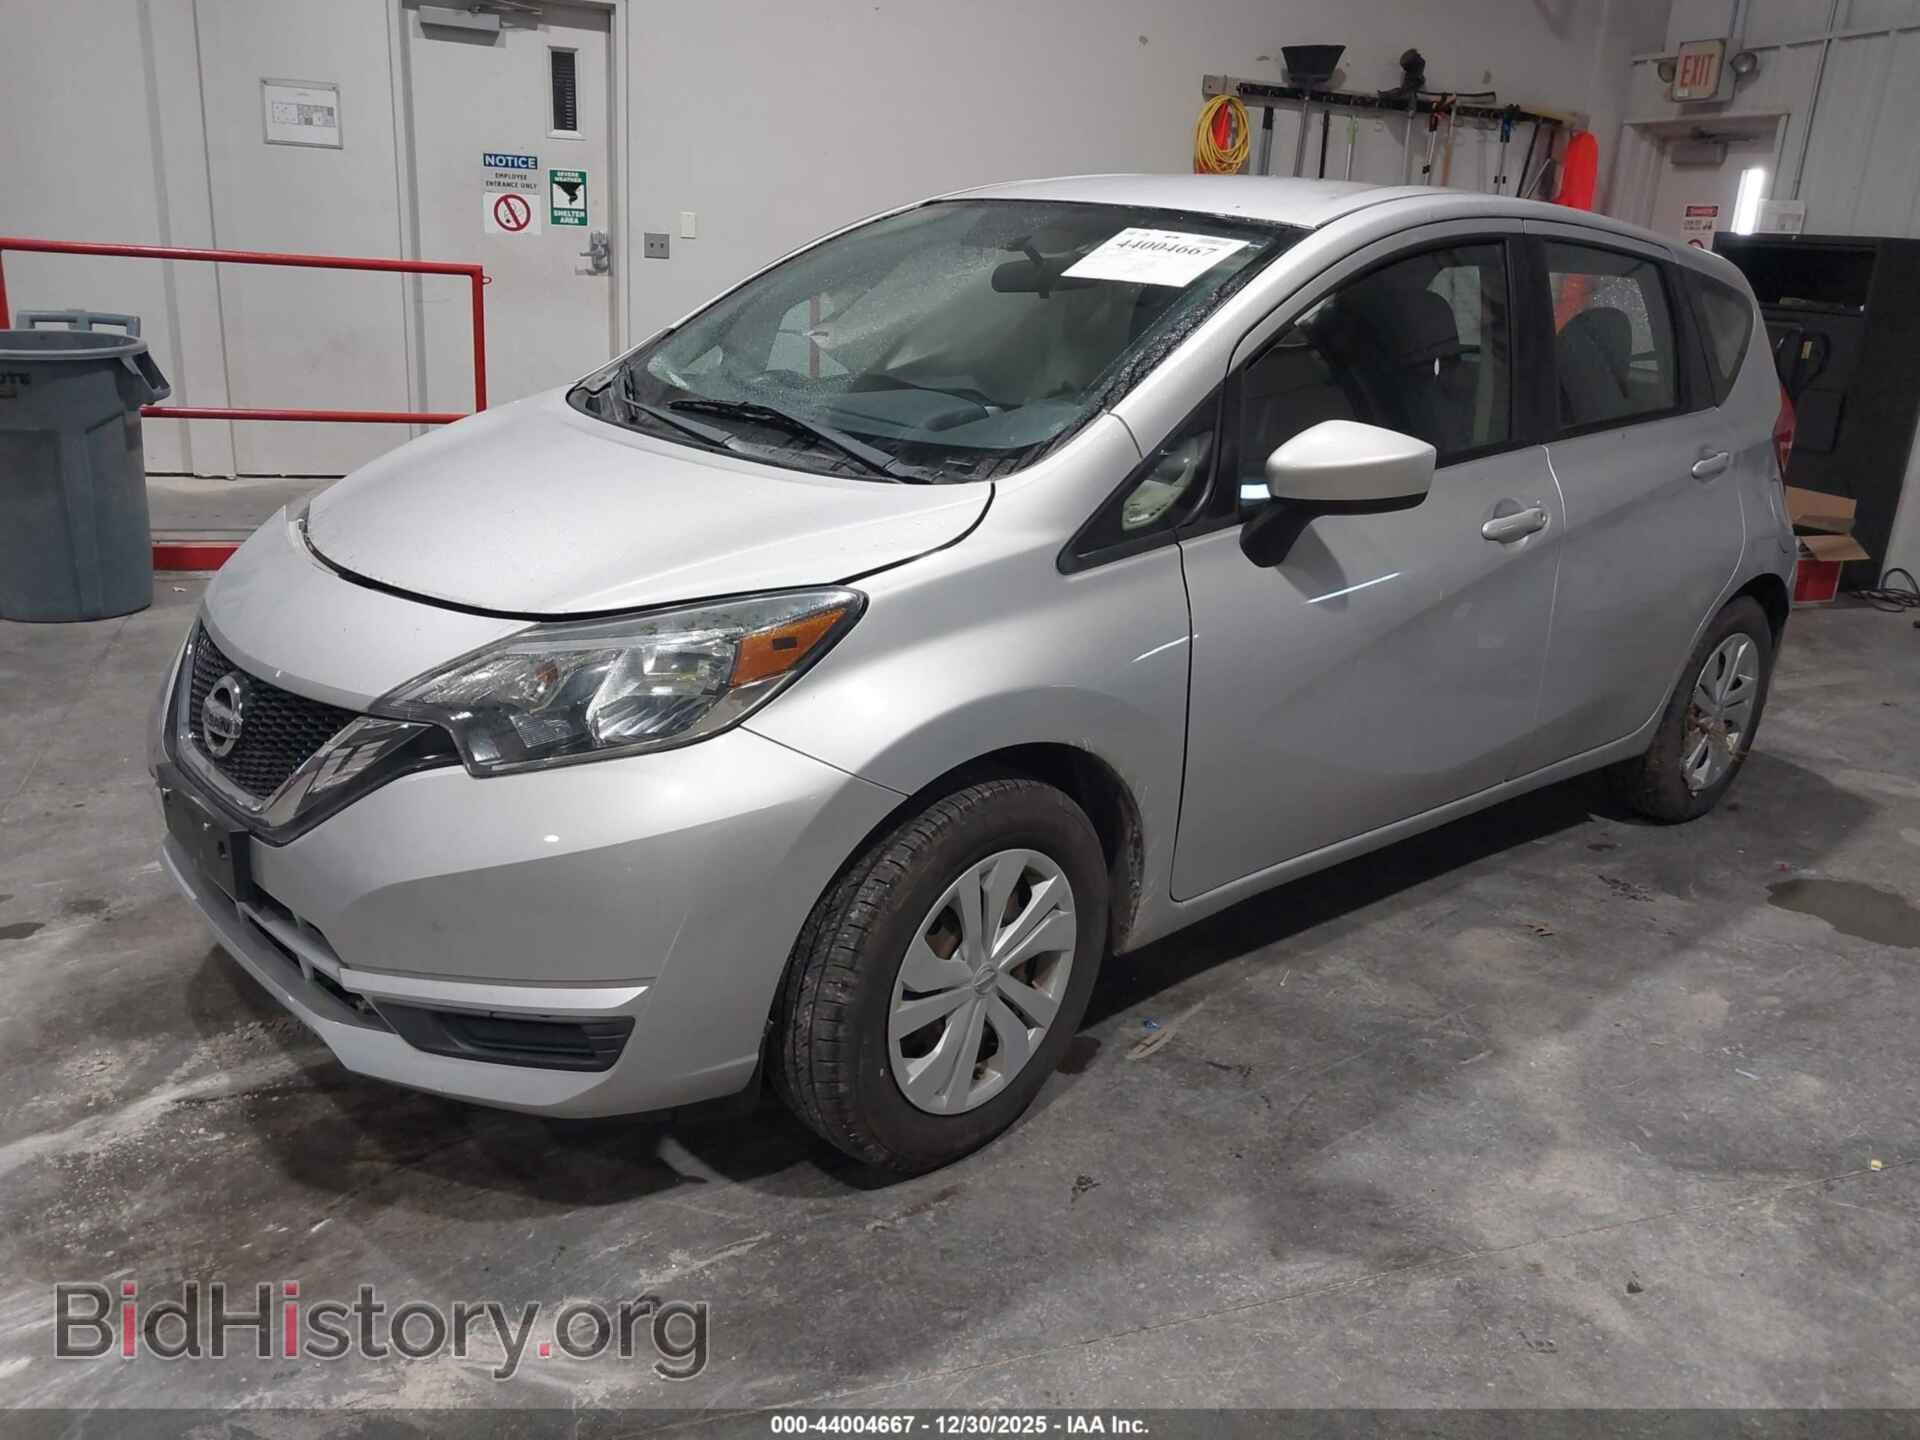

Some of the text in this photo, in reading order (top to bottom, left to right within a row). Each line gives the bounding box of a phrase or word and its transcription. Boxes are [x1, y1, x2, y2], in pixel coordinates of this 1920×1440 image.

[1680, 55, 1714, 88] EXIT
[485, 155, 536, 168] NOTICE
[495, 172, 527, 180] EMPLOYEE
[486, 180, 518, 188] ENTRANCE
[1116, 239, 1218, 257] 44004667
